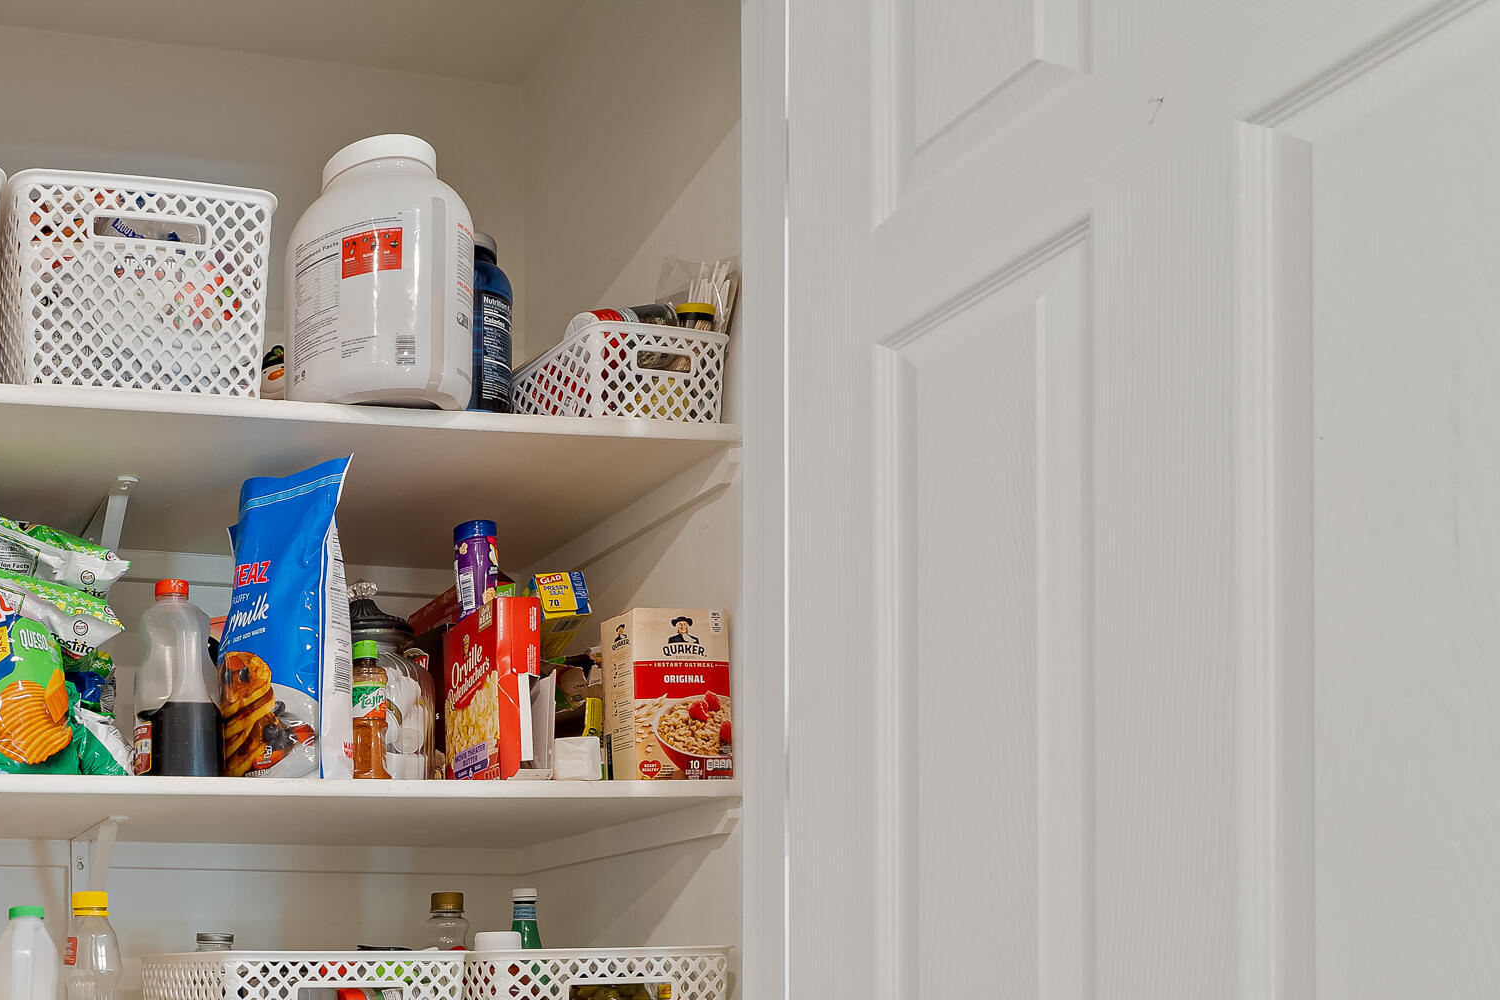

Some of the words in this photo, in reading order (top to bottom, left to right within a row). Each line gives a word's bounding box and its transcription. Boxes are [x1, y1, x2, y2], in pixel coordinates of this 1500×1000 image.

[540, 574, 562, 584] GLAD
[548, 599, 560, 607] 70
[19, 629, 49, 650] QUESO
[612, 639, 630, 651] QUAKER
[662, 644, 705, 657] QUAKER
[451, 644, 483, 689] Orville
[663, 674, 706, 684] ORIGINAL
[689, 759, 700, 769] 10
